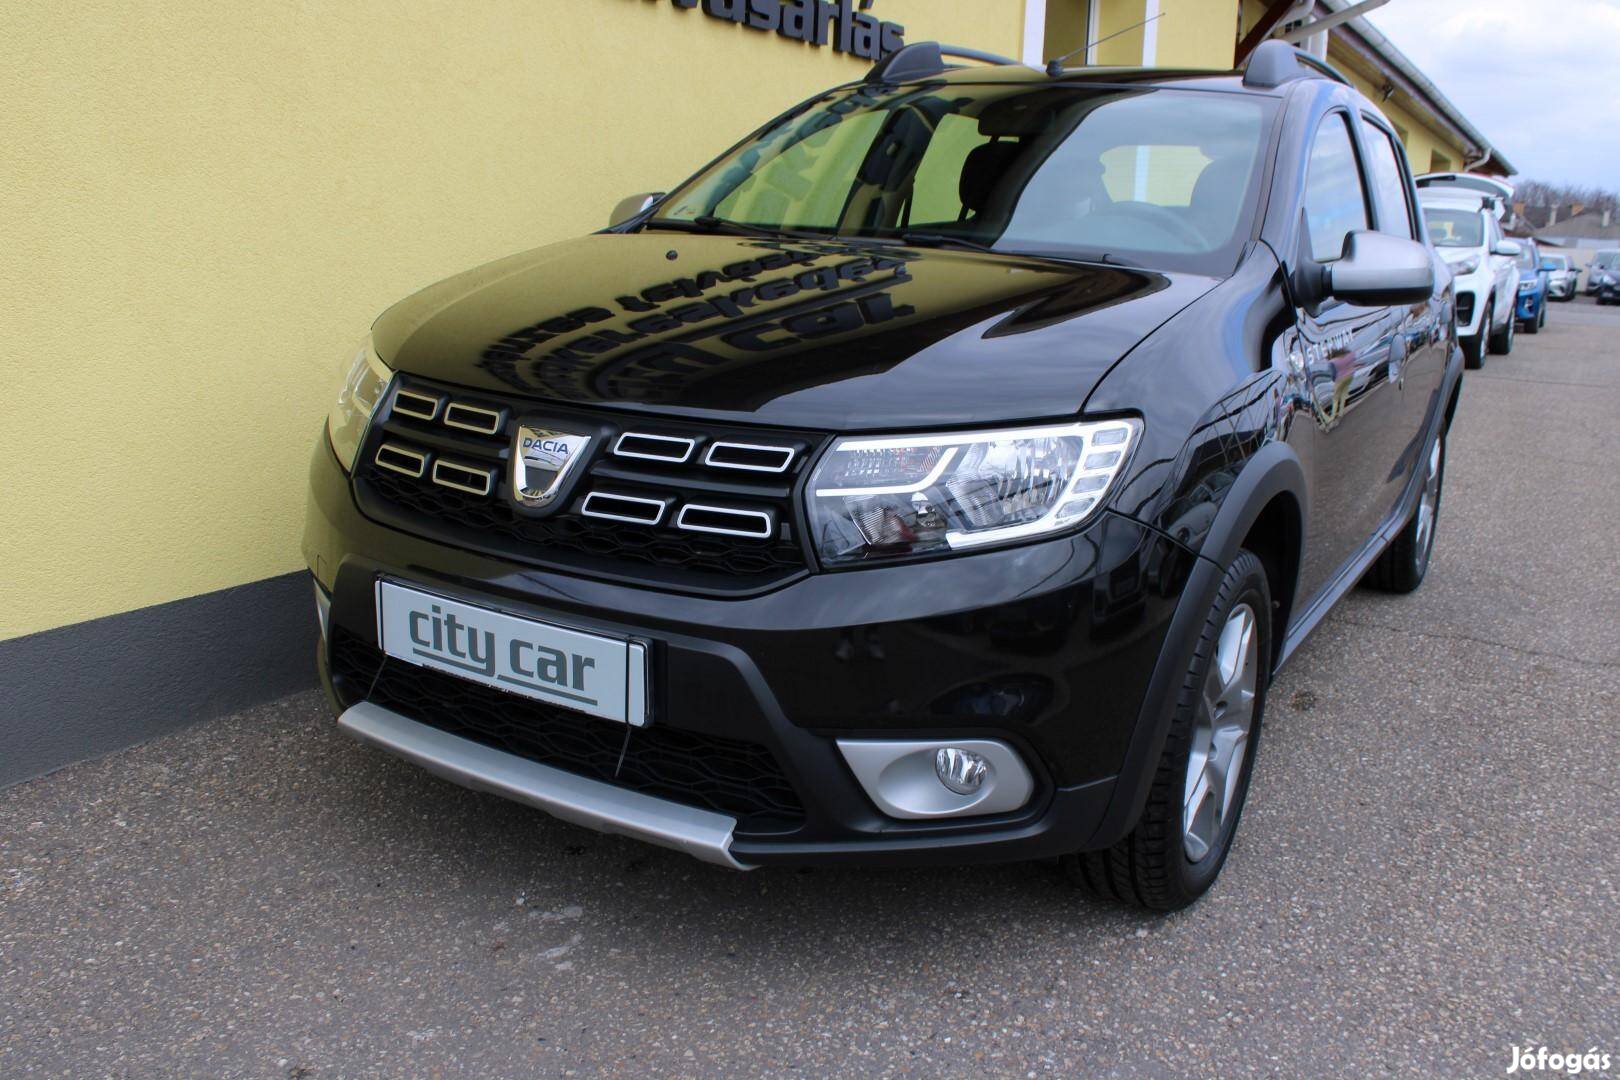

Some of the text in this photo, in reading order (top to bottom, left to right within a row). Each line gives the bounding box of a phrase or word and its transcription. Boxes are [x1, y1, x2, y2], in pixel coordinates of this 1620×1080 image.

[522, 437, 569, 455] DACIA
[408, 604, 496, 678] city
[509, 638, 596, 692] car
